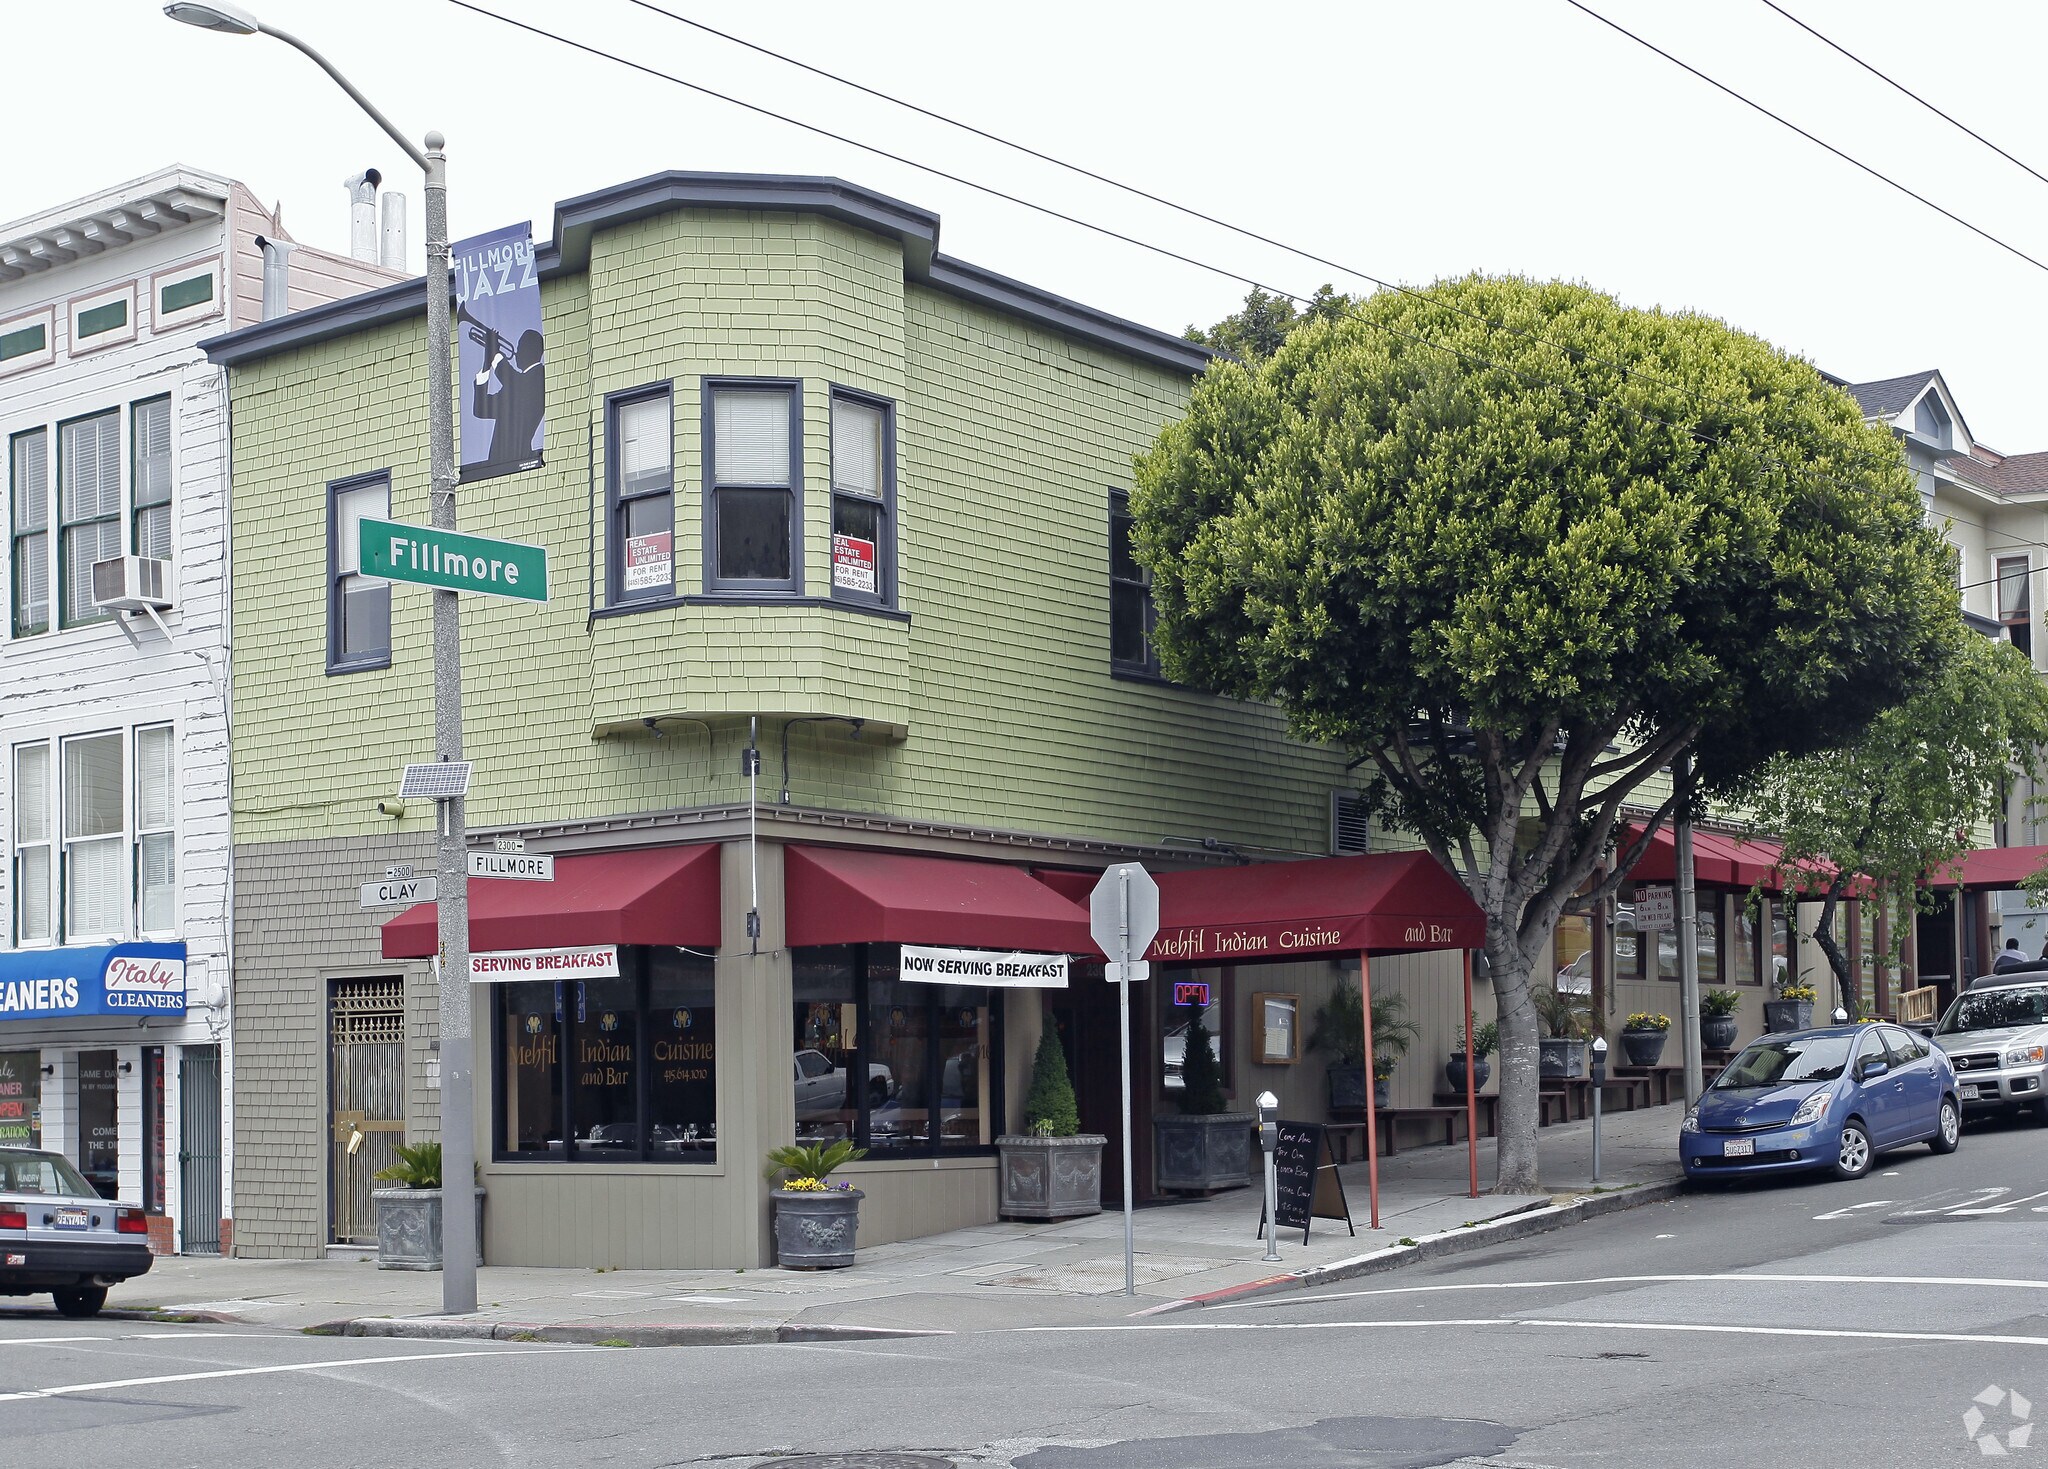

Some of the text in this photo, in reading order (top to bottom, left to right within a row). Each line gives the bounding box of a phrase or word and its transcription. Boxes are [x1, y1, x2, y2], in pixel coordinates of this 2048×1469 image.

[453, 238, 535, 277] FILLMORE
[456, 255, 539, 303] JAZZ
[629, 539, 646, 548] REAL
[632, 545, 658, 556] ESTATE
[835, 546, 860, 557] ESTATE
[390, 536, 519, 585] Fillmore
[635, 552, 670, 565] UNLIMITED
[837, 554, 872, 569] UNLIMITED
[633, 564, 667, 576] FOR RENT
[836, 566, 868, 579] FOR RENT
[497, 839, 515, 851] 2300
[393, 866, 410, 878] 2500
[476, 856, 544, 875] FILLMORE
[378, 882, 418, 901] CLAY
[1635, 890, 1672, 902] NO PARKING
[1404, 922, 1453, 943] and Bar
[1152, 926, 1341, 959] Mehfil Indian Cuisine
[472, 952, 613, 973] SERVING BREAKFAST
[904, 956, 1065, 978] NOW SERVING BREAKFAST
[110, 958, 182, 990] Italy
[106, 992, 184, 1009] CLEANERS
[1175, 984, 1208, 1004] OPEN
[508, 1034, 713, 1073] Mehfil Indian Cuisine
[581, 1067, 629, 1085] and Bar
[92, 1127, 118, 1136] COME
[88, 1141, 104, 1150] THE
